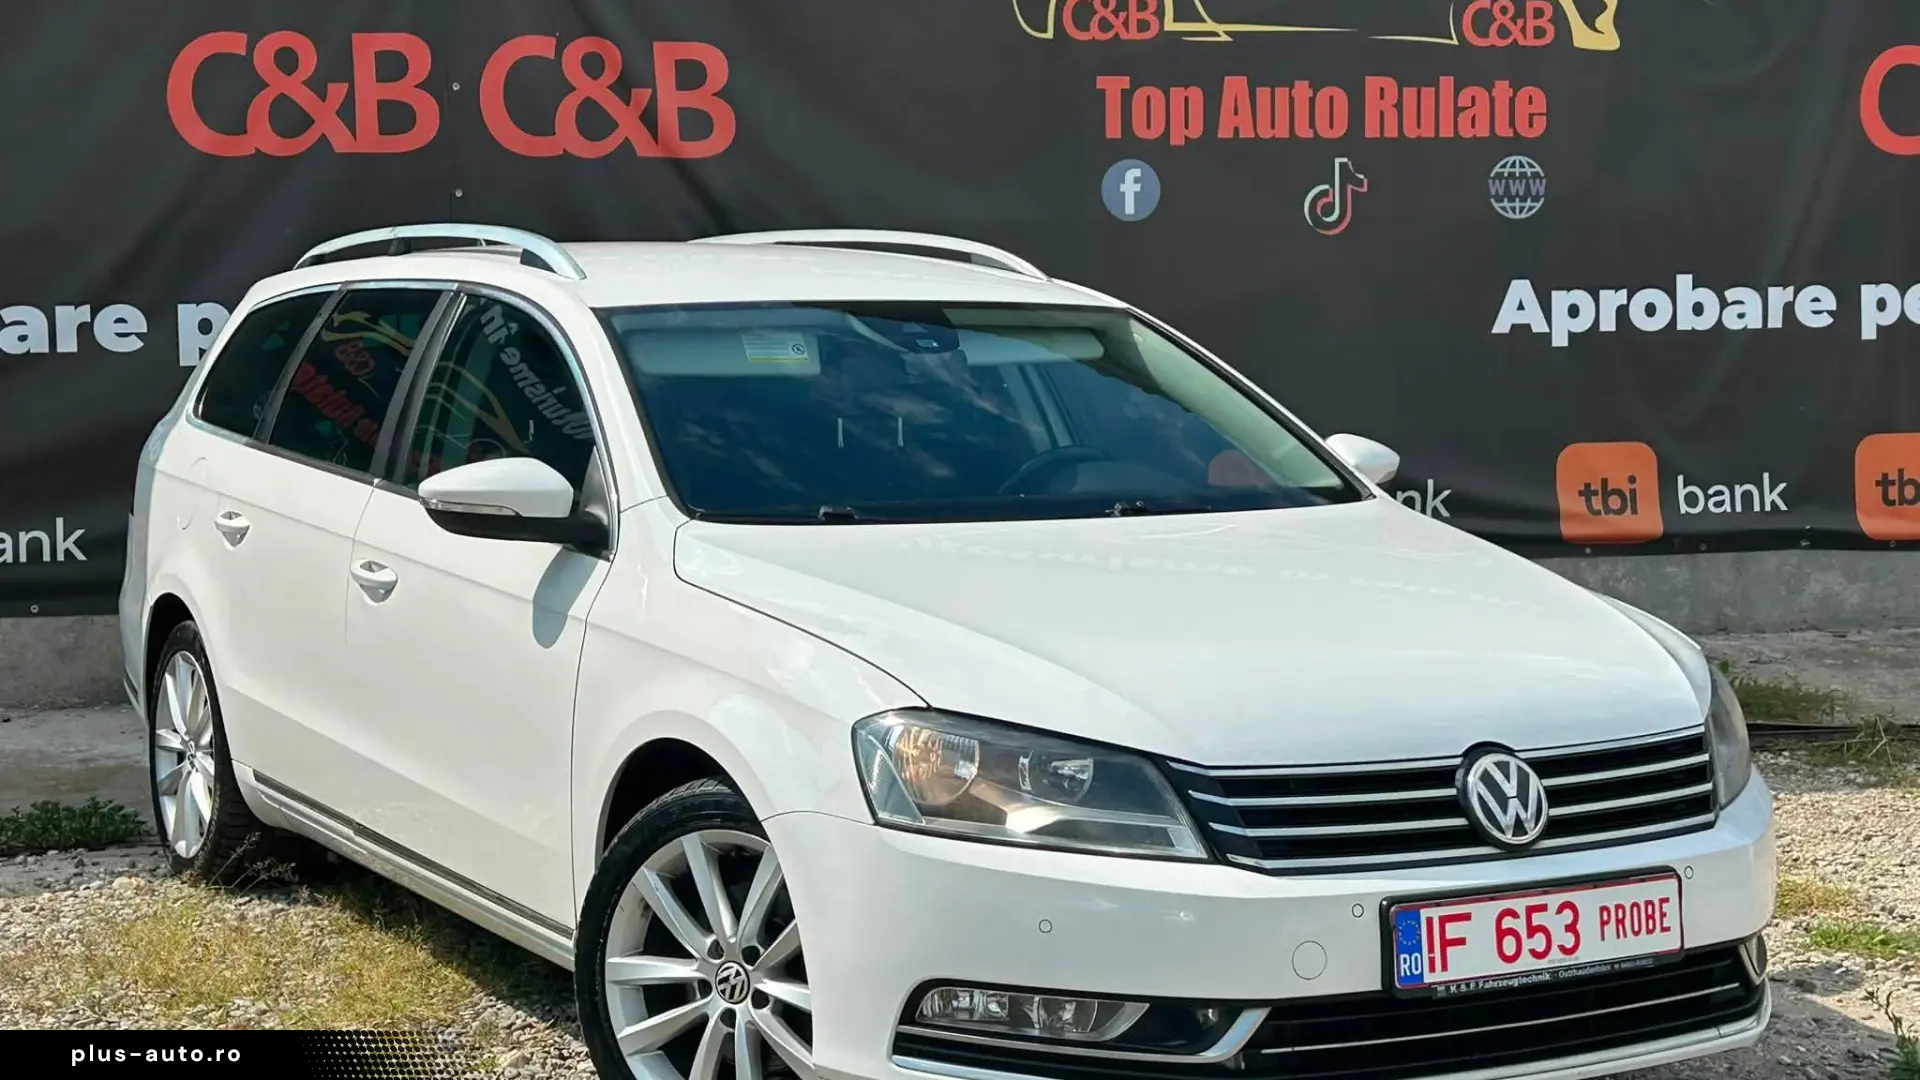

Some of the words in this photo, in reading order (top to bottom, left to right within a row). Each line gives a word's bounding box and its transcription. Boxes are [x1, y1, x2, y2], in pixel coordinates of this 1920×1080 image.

[1063, 0, 1159, 40] C&B
[1462, 0, 1555, 47] C&B
[167, 31, 440, 157] C&B
[480, 35, 736, 158] C&B
[1096, 75, 1204, 146] Top
[1217, 75, 1348, 139] Auto
[1364, 75, 1547, 139] Rulate
[1491, 274, 1837, 347] Aprobare
[1578, 475, 1639, 516] tbi
[1677, 472, 1788, 514] bank
[1400, 952, 1422, 977] RO
[1425, 911, 1472, 974] IF
[1495, 900, 1581, 964] 653
[1599, 896, 1672, 942] PROBE
